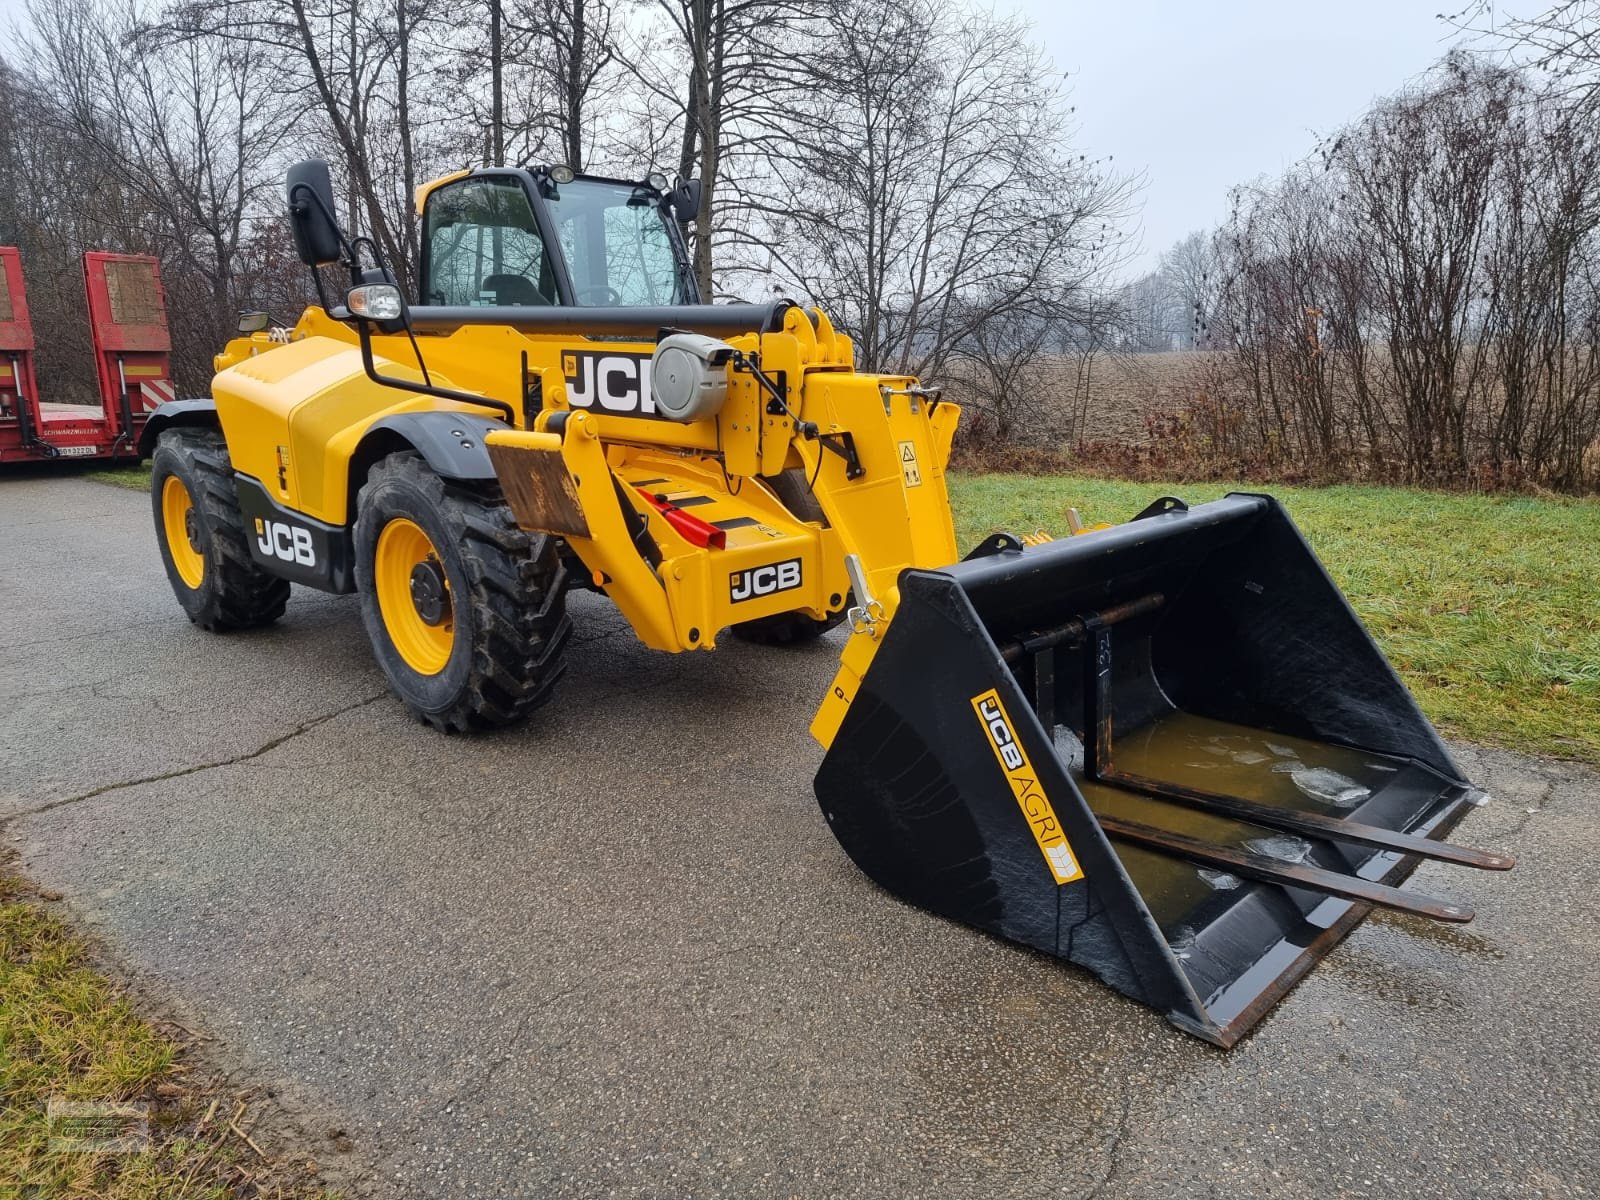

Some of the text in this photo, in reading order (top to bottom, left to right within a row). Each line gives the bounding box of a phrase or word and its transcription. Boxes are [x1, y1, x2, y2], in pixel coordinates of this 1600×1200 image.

[258, 520, 315, 567] JCB
[732, 561, 800, 600] JCB
[980, 701, 1062, 843] JCB AGRI
